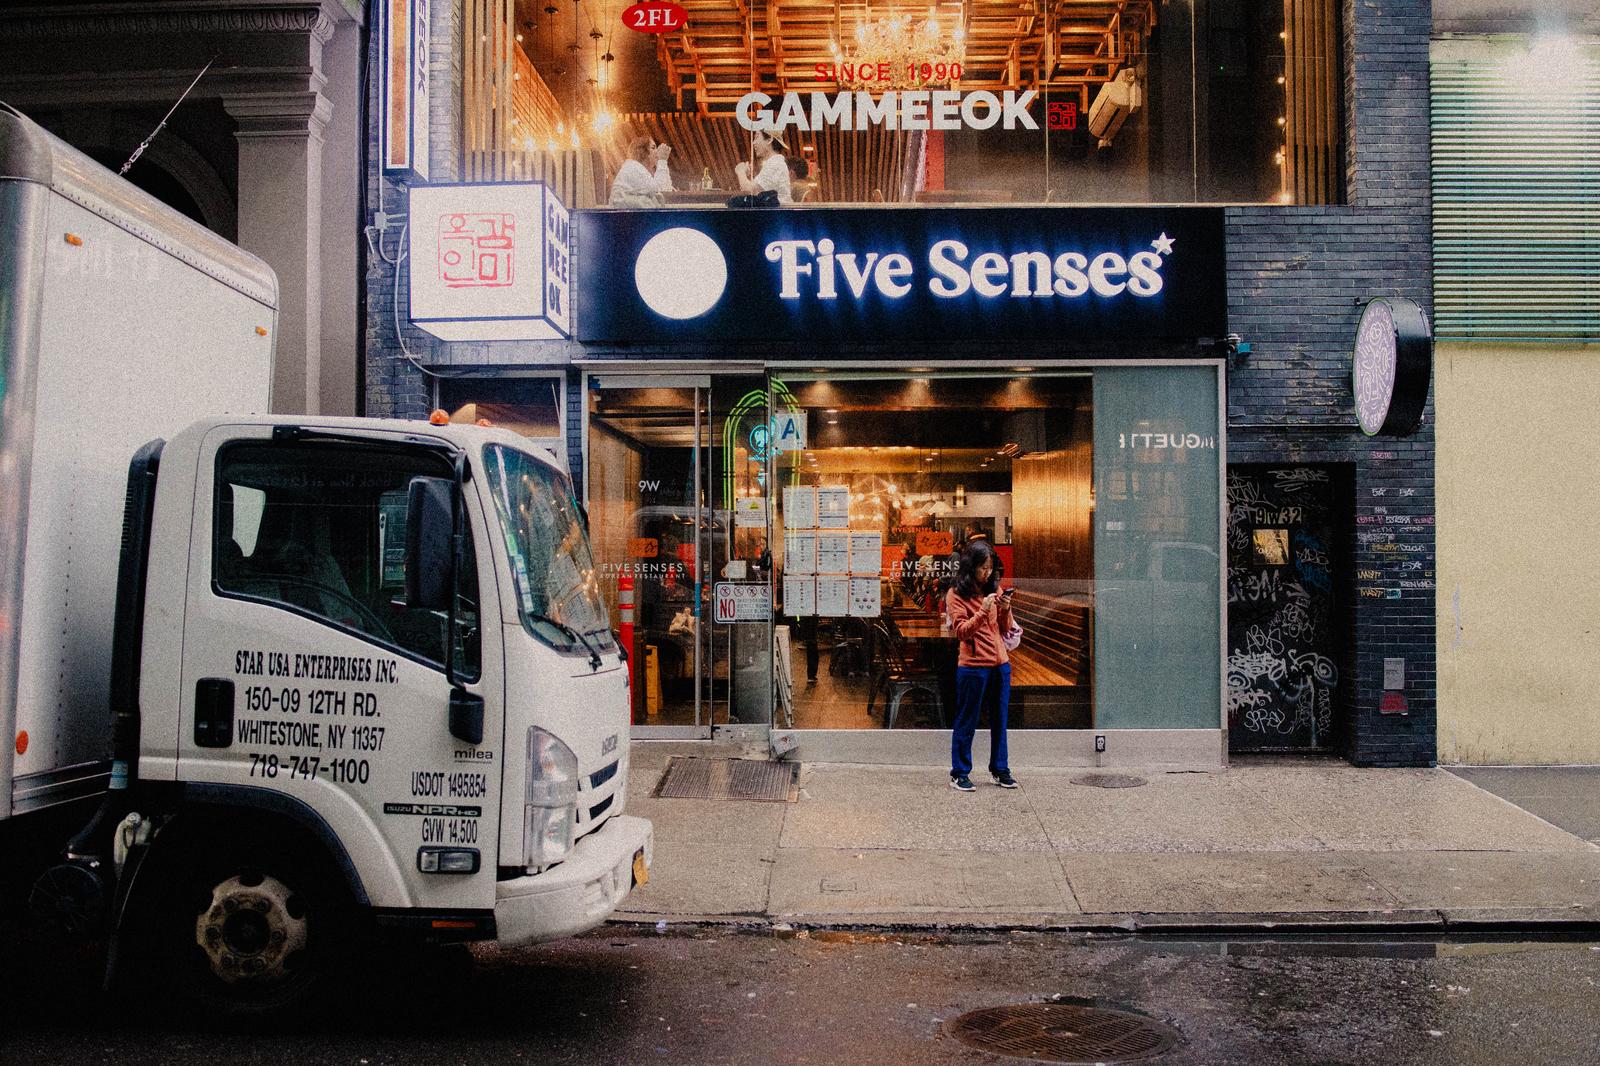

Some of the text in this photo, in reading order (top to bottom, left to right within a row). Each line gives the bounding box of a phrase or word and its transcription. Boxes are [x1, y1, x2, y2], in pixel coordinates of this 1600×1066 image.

[633, 9, 678, 27] 2FL
[814, 62, 963, 82] SINCE 1990
[735, 90, 1040, 132] GAMMEEOK
[548, 203, 568, 249] GAM
[548, 240, 567, 284] MEE
[764, 238, 1165, 300] Five Senses
[549, 282, 562, 317] OK
[781, 418, 800, 440] A
[638, 480, 660, 492] 9W
[602, 563, 683, 572] FIVE SENSES
[892, 560, 960, 570] FIVE SENS
[720, 599, 736, 618] NO
[235, 650, 264, 675] STAR
[269, 652, 290, 677] USA
[294, 654, 372, 682] ENTERPRISES
[245, 686, 381, 717] 150-09 12TH RD.
[238, 719, 385, 752] WHITESTONE, NY 11357
[454, 747, 493, 759] milea
[249, 753, 370, 784] 718-747-1100
[411, 771, 486, 798] USDOT 1495854
[421, 818, 445, 842] GVW
